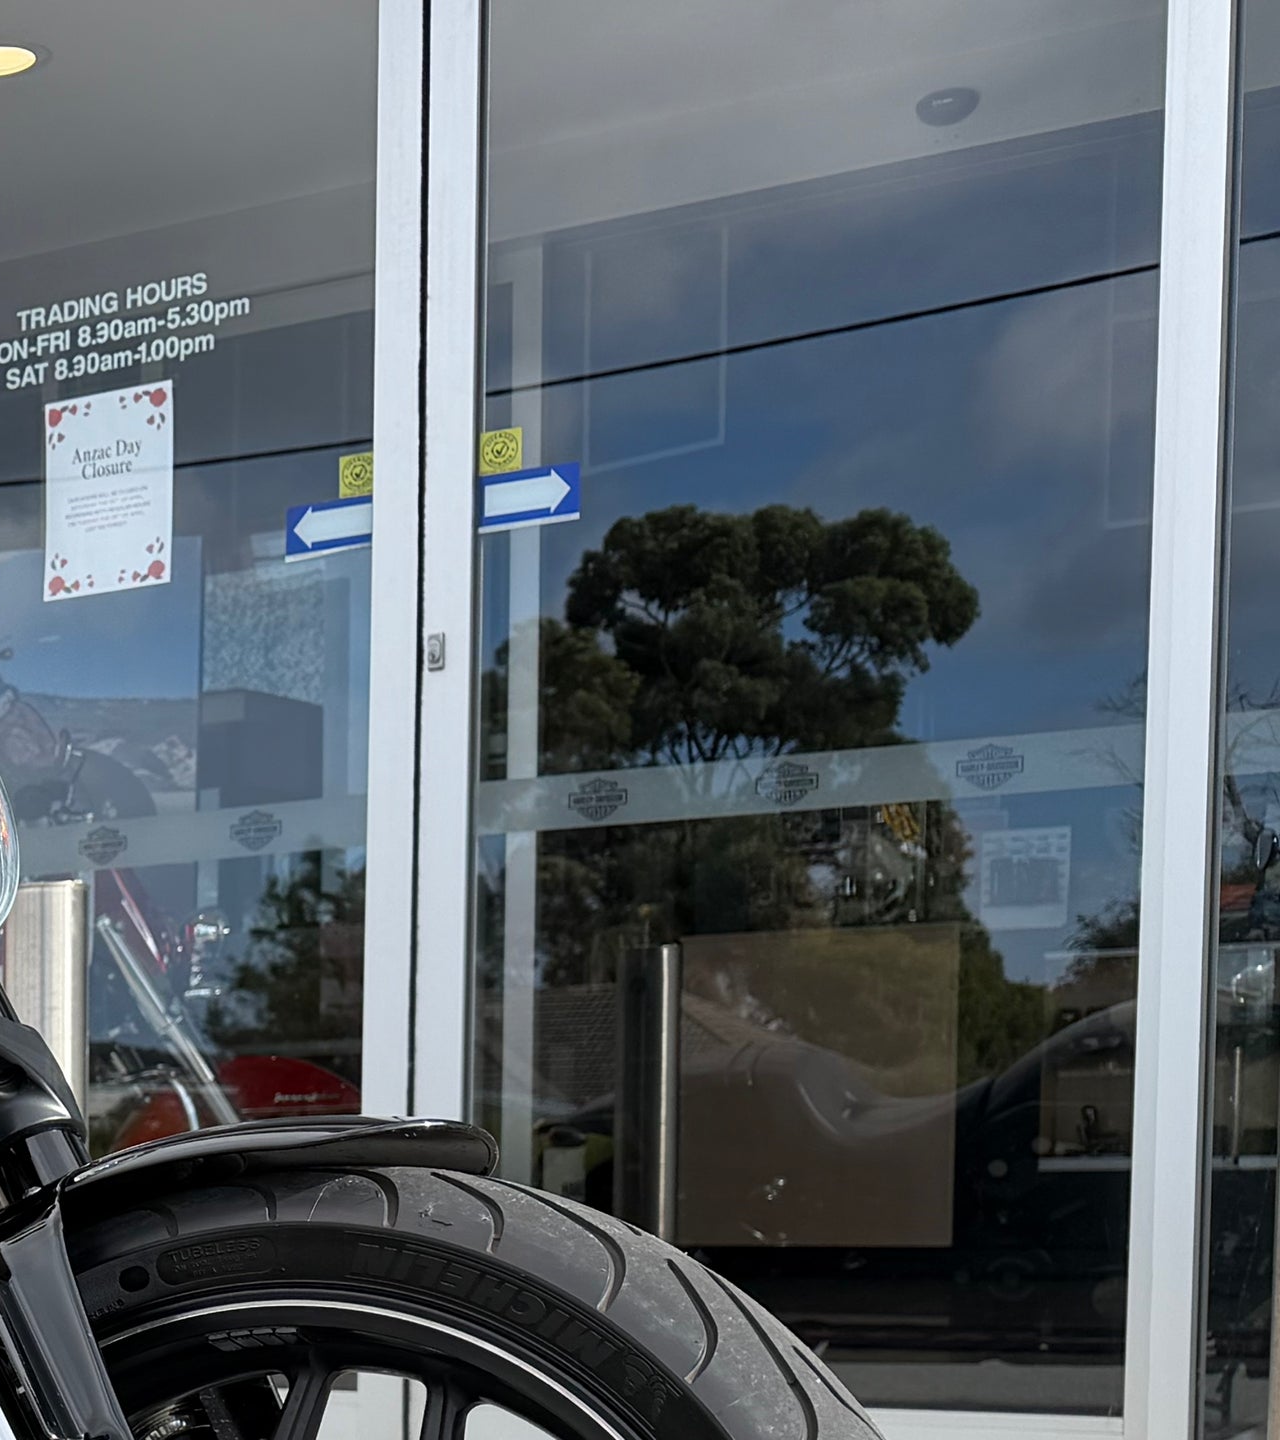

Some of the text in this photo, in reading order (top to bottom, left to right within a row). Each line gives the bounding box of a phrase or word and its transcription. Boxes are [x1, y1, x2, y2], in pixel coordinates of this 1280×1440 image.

[16, 272, 208, 332] TRADING HOURS
[5, 362, 49, 390] SAT
[72, 439, 142, 465] Anzac Day
[81, 460, 133, 480] Closure
[168, 1238, 263, 1264] TUBELESS
[352, 1242, 625, 1370] MICHELIN
